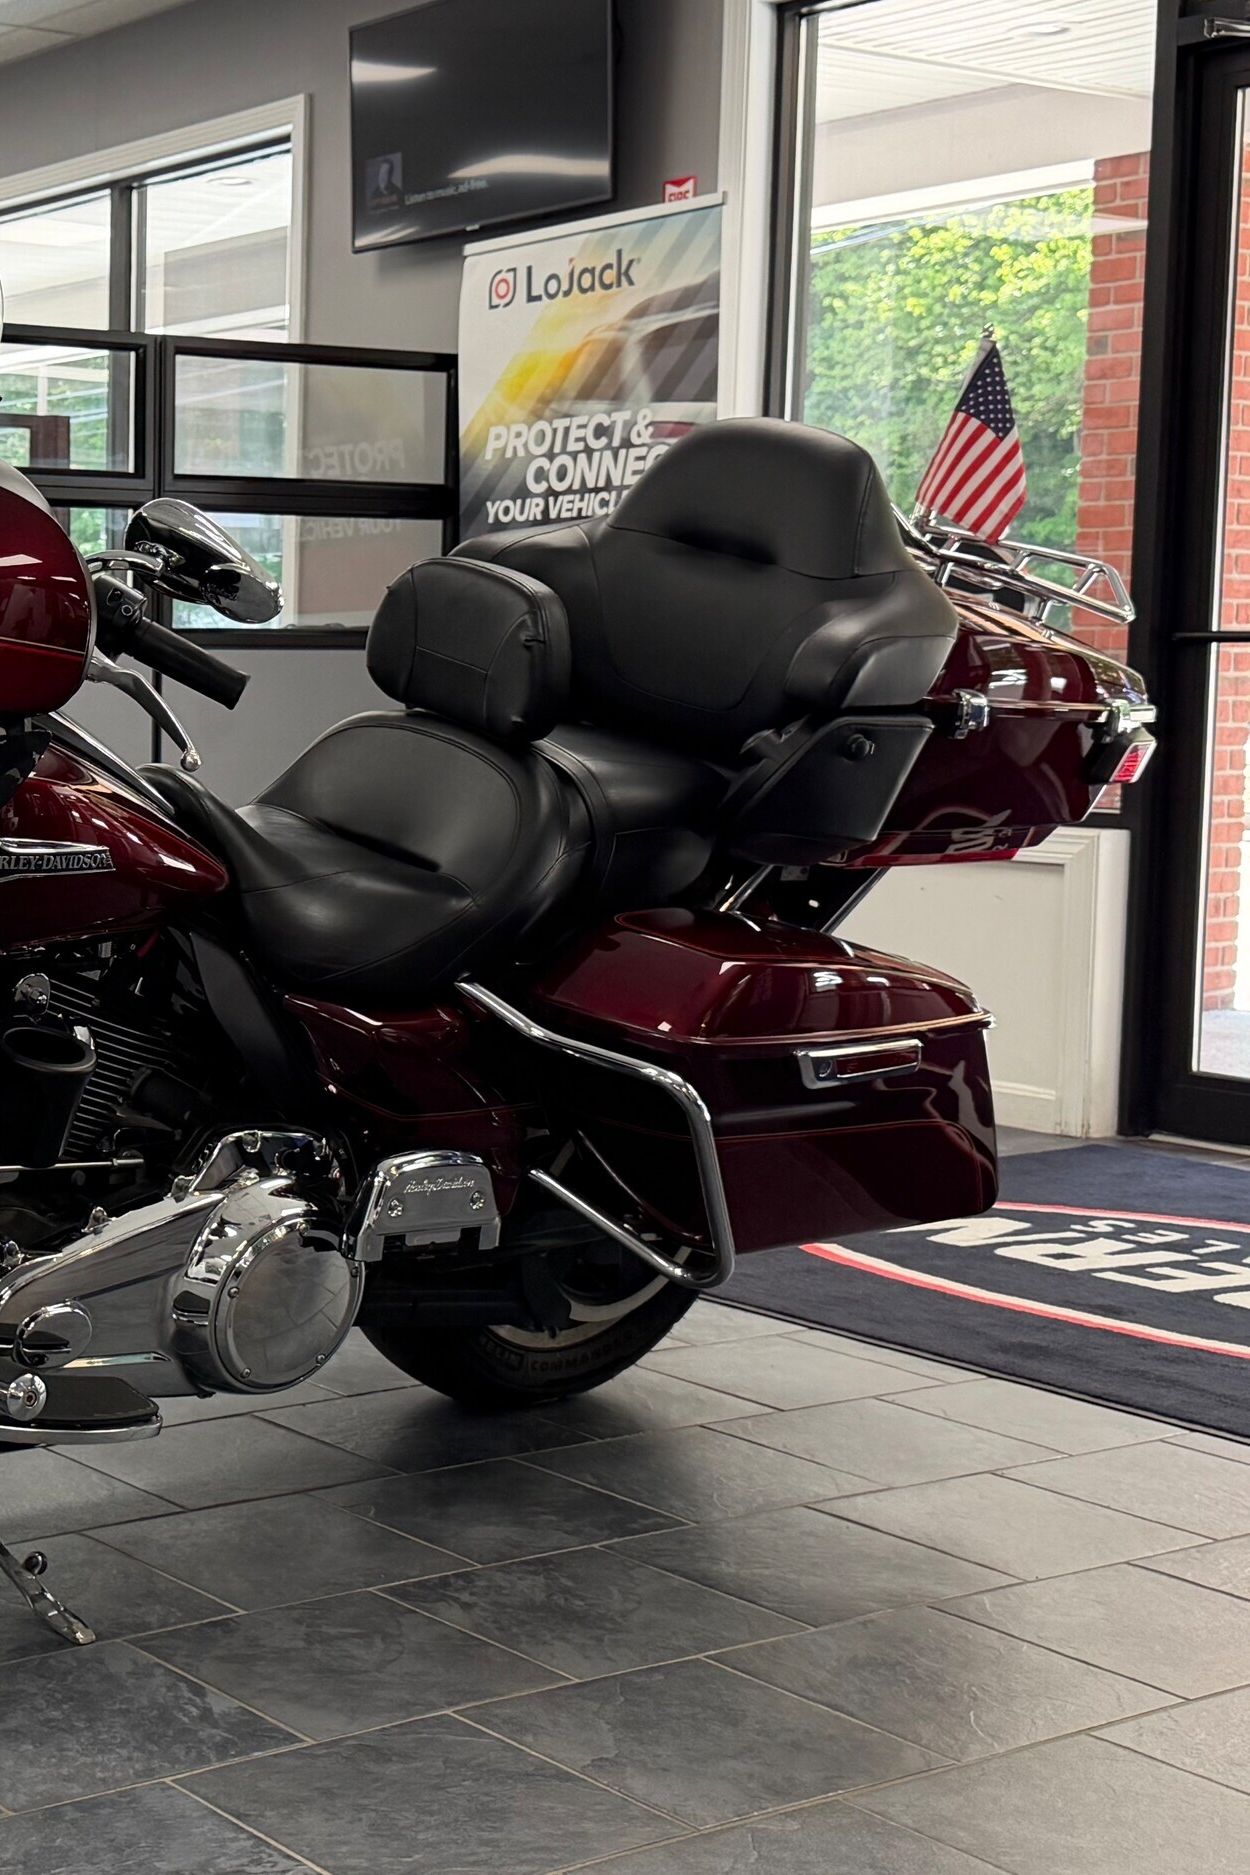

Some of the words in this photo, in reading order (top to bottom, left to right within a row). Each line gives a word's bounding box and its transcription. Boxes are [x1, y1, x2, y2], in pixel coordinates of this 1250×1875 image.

[485, 410, 631, 460] PROTECT
[630, 408, 653, 446] &
[486, 498, 545, 524] YOUR
[548, 489, 630, 519] VEHICL
